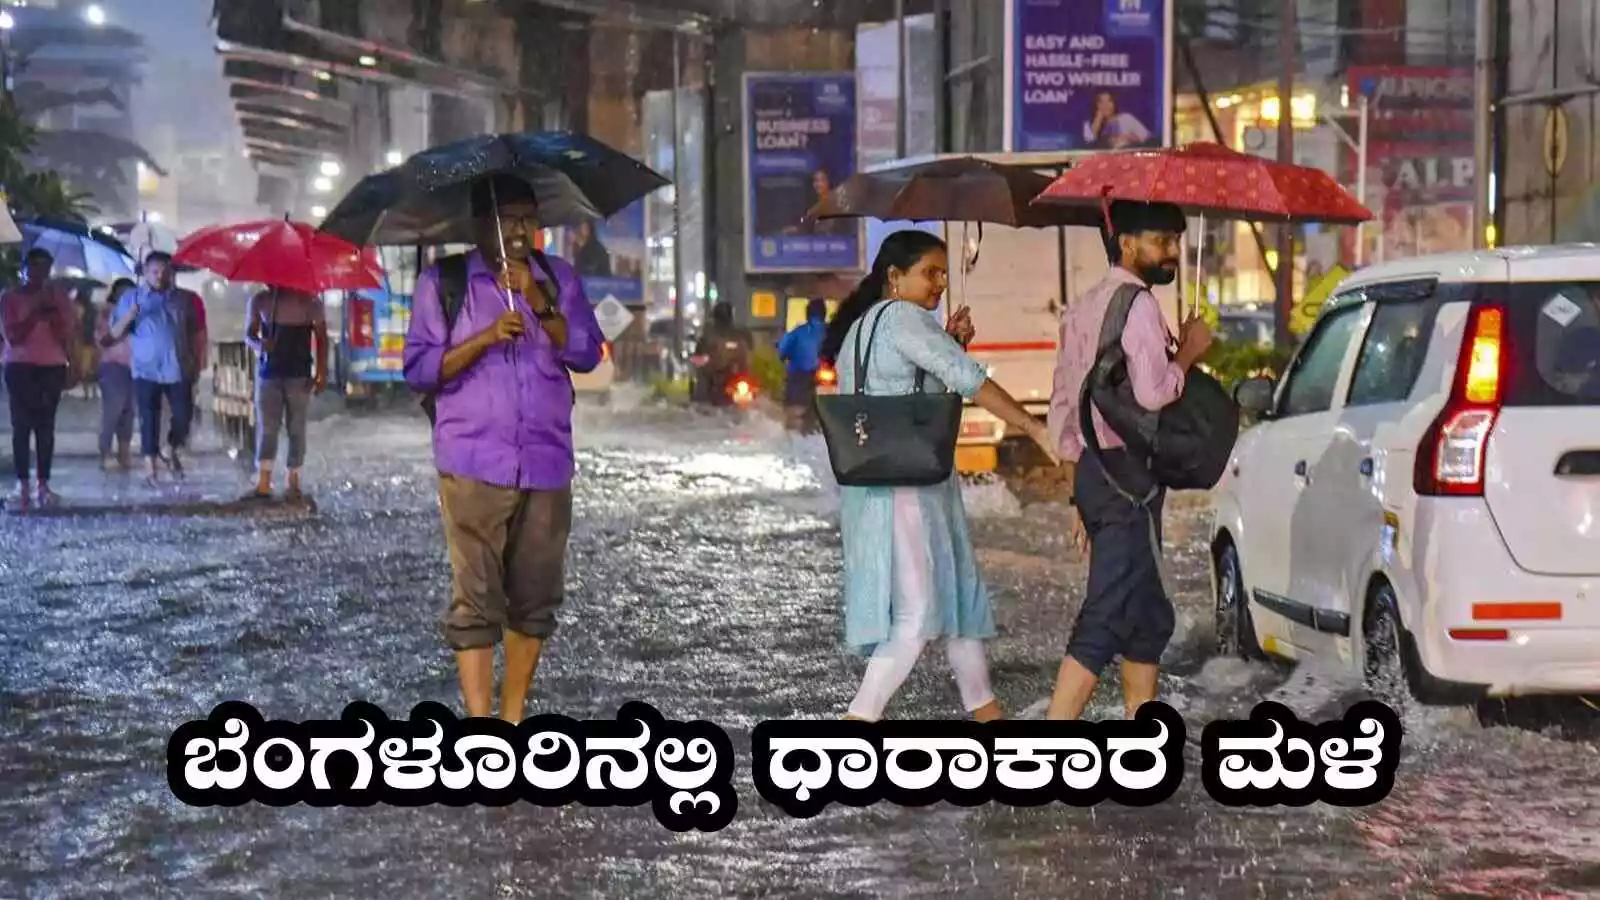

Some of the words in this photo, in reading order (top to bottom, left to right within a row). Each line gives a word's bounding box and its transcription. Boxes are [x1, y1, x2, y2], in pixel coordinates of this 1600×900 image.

[1024, 35, 1066, 50] EASY
[1069, 35, 1105, 50] AND
[1025, 53, 1129, 68] HASSLE-FREE
[1025, 71, 1065, 86] TWO
[1068, 71, 1141, 86] WHEELER
[756, 118, 831, 134] BUSINESS
[756, 134, 808, 150] LOAN?
